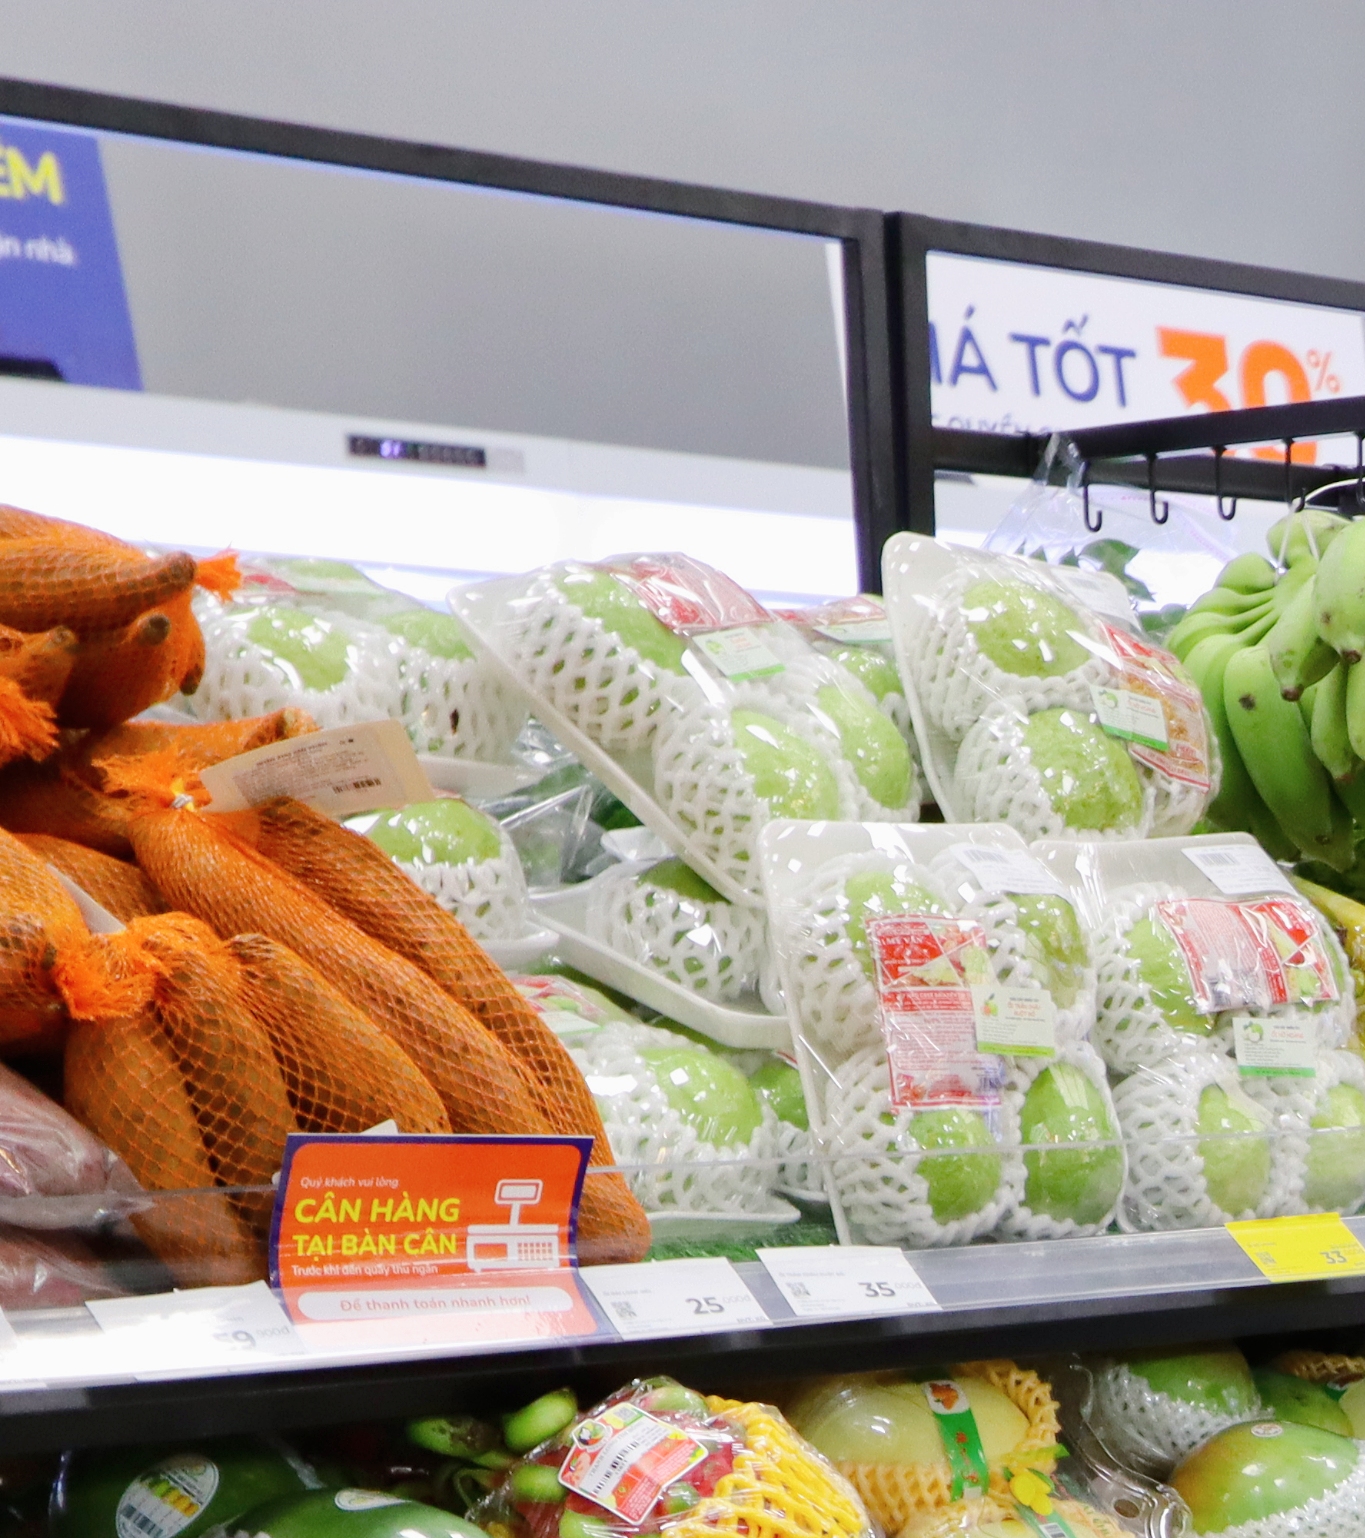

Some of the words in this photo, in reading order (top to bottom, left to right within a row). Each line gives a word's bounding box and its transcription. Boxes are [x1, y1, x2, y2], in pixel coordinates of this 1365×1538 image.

[1008, 314, 1138, 408] TỐT
[301, 1175, 322, 1189] Quý
[325, 1177, 355, 1188] khách
[358, 1177, 375, 1188] vui
[378, 1177, 399, 1190] lòng
[295, 1192, 361, 1223] CÂN
[370, 1192, 460, 1223] HÀNG
[292, 1234, 333, 1262] TẠI
[341, 1228, 395, 1255] BÀN
[403, 1228, 457, 1255] CÂN
[1320, 1251, 1347, 1265] 33
[324, 1264, 340, 1275] khi
[392, 1262, 411, 1274] thu
[858, 1282, 896, 1298] 35
[340, 1293, 362, 1312] Để
[366, 1296, 409, 1311] thanh
[415, 1295, 446, 1309] toán
[452, 1294, 496, 1309] nhanh
[500, 1295, 530, 1306] hơn!
[686, 1297, 724, 1314] 25
